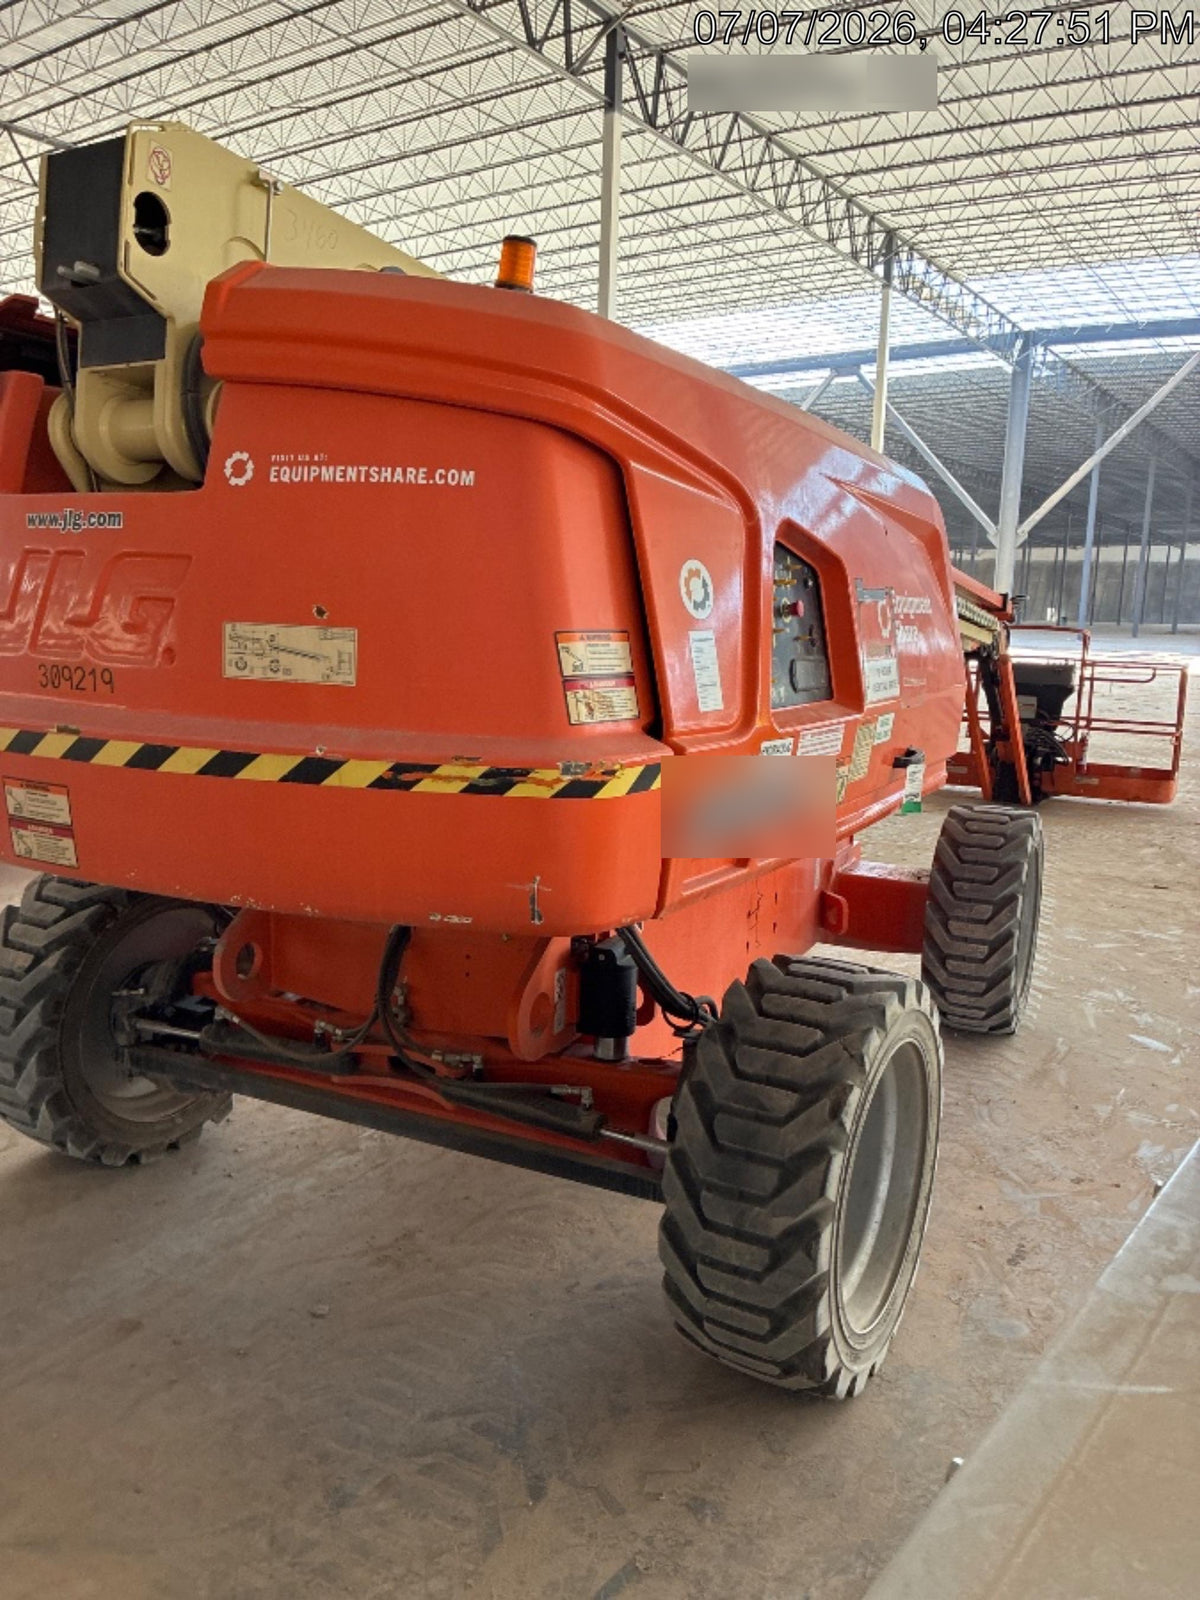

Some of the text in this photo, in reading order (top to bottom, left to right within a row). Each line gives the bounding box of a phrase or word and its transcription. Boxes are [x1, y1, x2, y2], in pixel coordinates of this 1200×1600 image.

[269, 464, 476, 487] EQUIPMENTSHARE.COM
[27, 509, 122, 533] www.jlg.com
[38, 663, 115, 694] 309219
